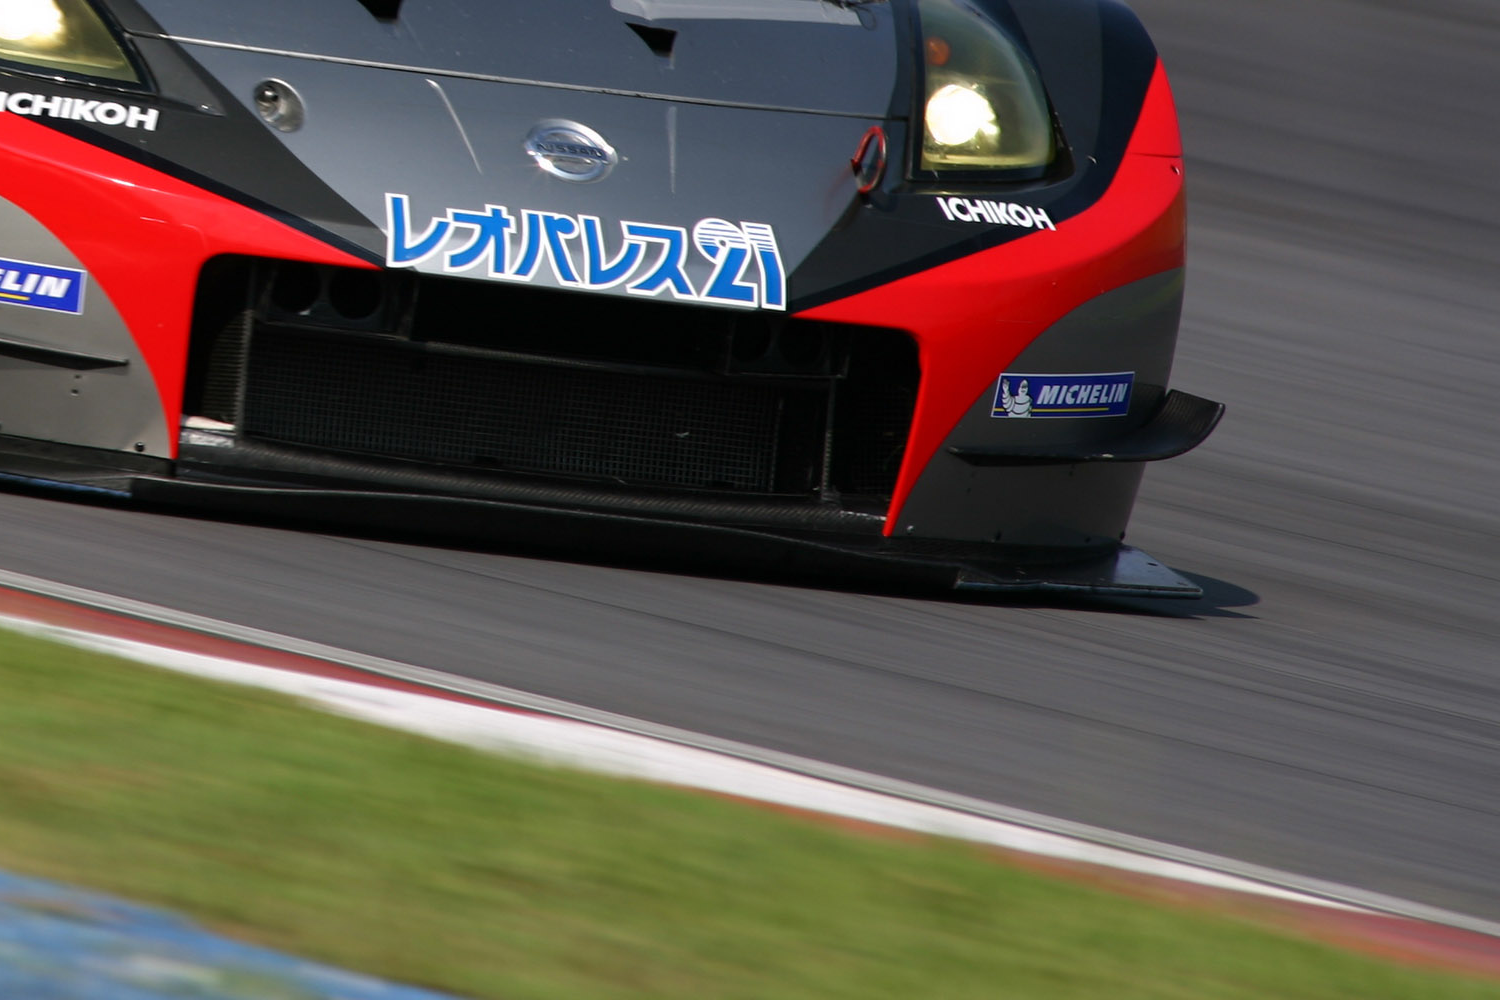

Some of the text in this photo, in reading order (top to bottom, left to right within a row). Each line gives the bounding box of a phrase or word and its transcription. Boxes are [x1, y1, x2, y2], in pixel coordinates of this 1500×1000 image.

[536, 143, 605, 158] NISSAN
[936, 196, 1056, 231] ICHIKOH
[384, 193, 787, 311] レオパレス21
[1036, 383, 1129, 405] MICHELIN
